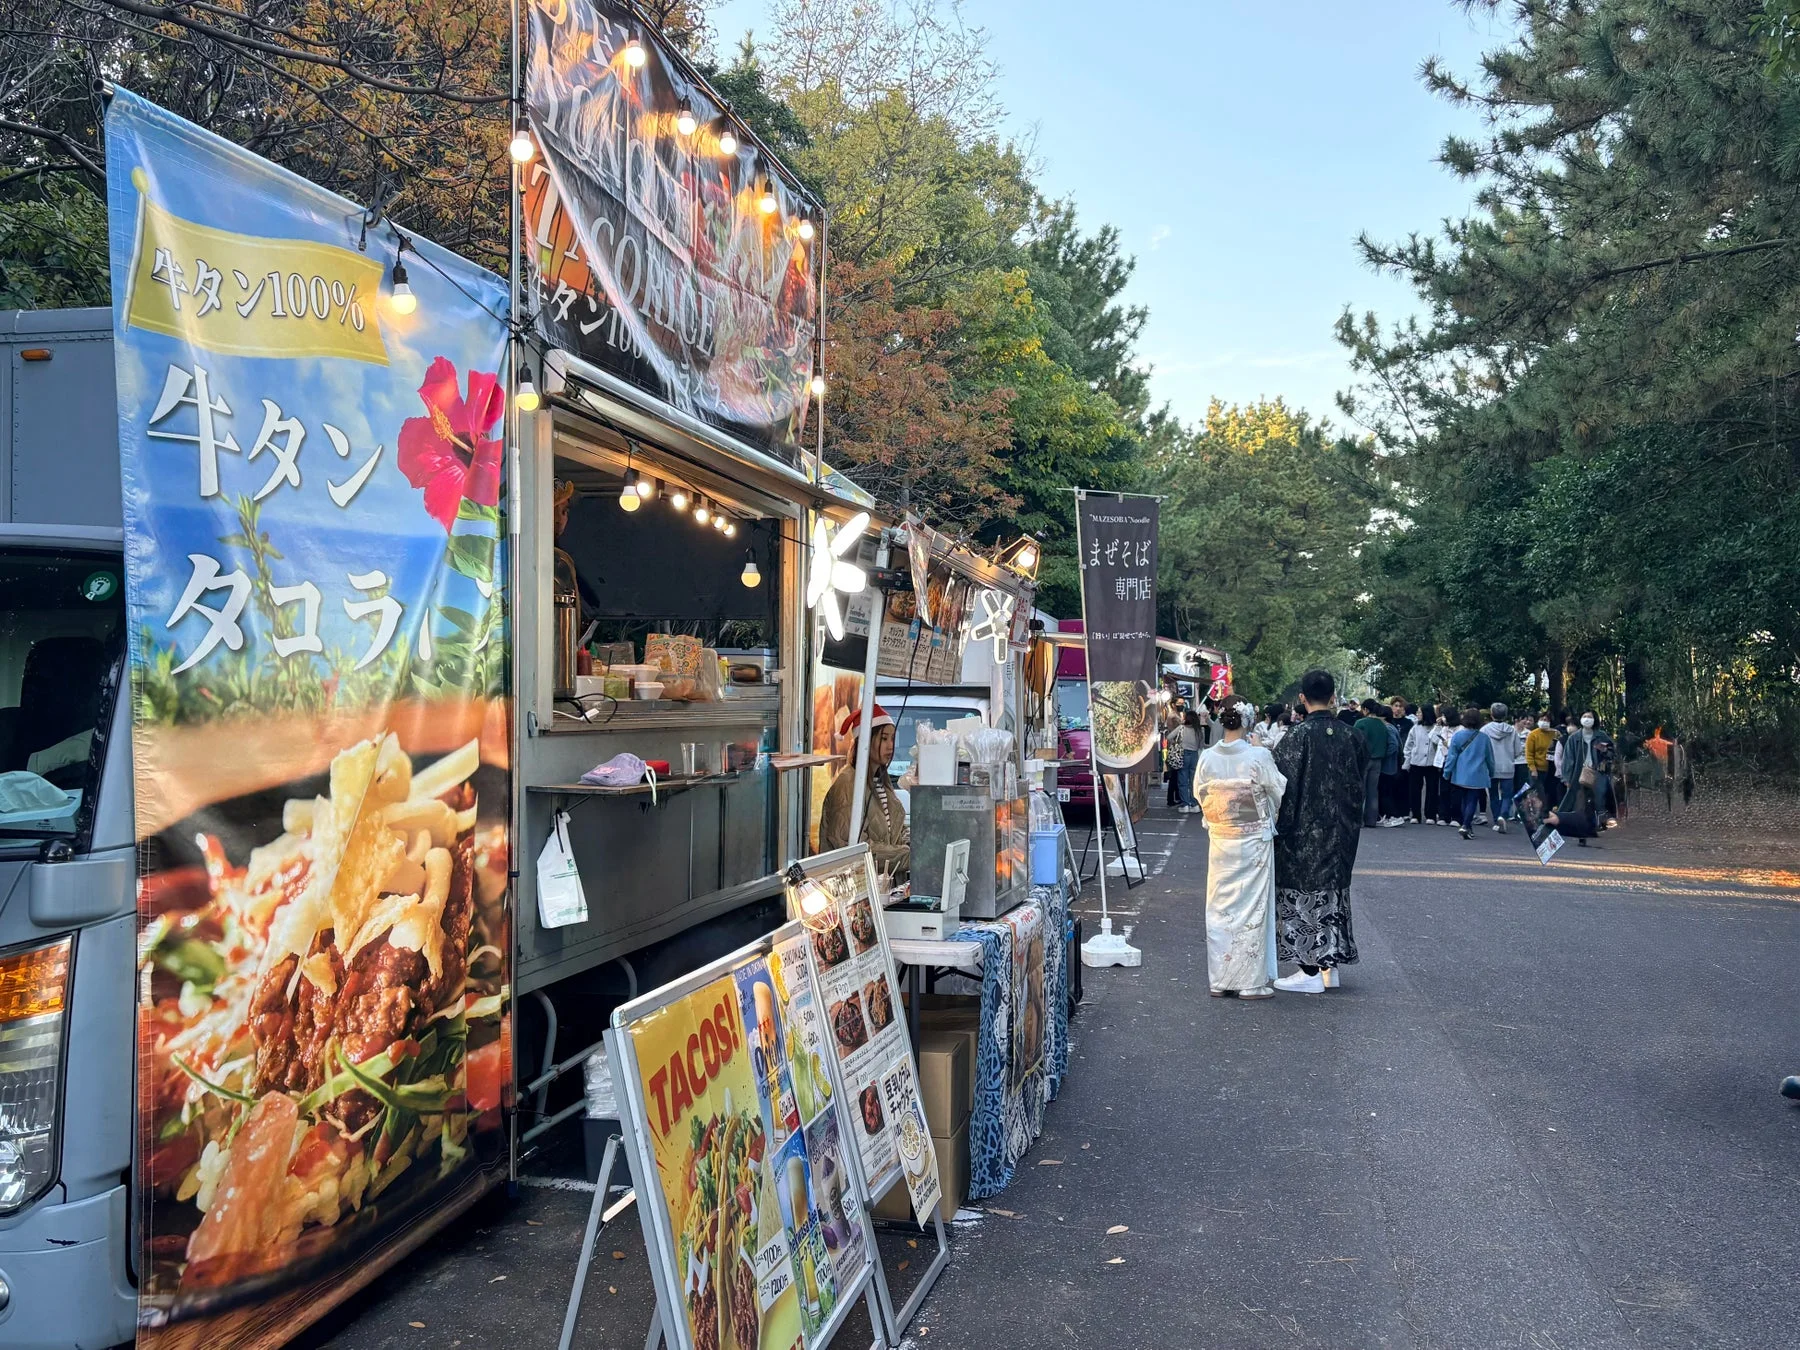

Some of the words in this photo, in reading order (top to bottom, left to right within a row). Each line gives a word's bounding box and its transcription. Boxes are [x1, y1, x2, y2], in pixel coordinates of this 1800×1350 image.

[151, 247, 364, 332] 牛タン100%
[147, 364, 384, 508] 牛タン
[1090, 538, 1151, 568] まぜそば
[1115, 576, 1151, 600] 専門店
[649, 993, 740, 1137] TACOS!
[755, 1033, 783, 1078] Orion
[885, 1062, 911, 1100] 豆乳クラム
[890, 1087, 916, 1120] チャウダー
